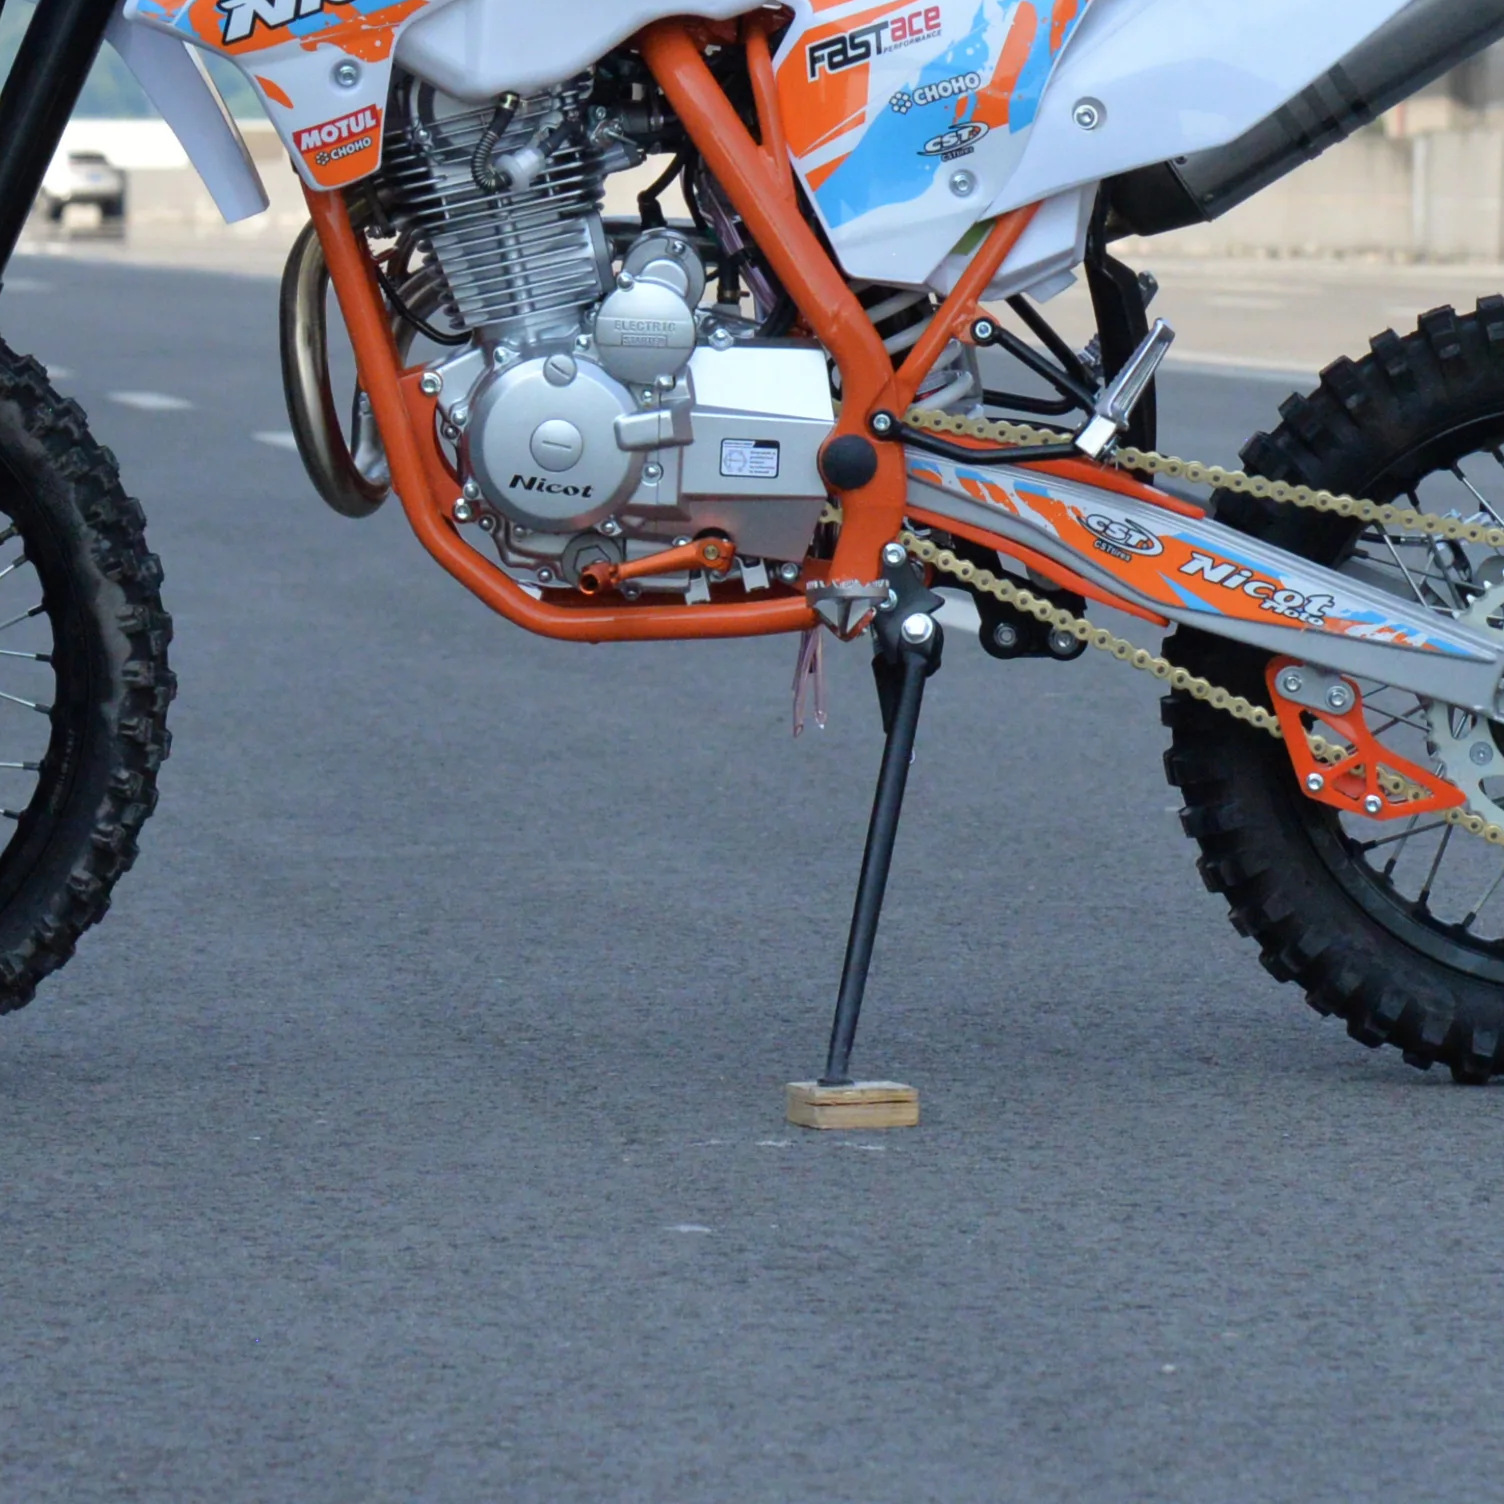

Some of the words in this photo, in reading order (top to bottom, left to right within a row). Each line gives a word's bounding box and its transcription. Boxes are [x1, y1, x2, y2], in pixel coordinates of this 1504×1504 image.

[882, 29, 942, 54] PERFORMANCE
[912, 71, 981, 106] CHOHO
[300, 109, 376, 151] MOTUL
[924, 125, 974, 153] CST
[330, 136, 372, 160] CHOHO
[614, 320, 676, 332] ELECTRIC
[509, 474, 593, 498] Nicot
[1086, 513, 1147, 549] CST
[1178, 551, 1334, 617] Nicot
[1260, 598, 1326, 627] Moto
